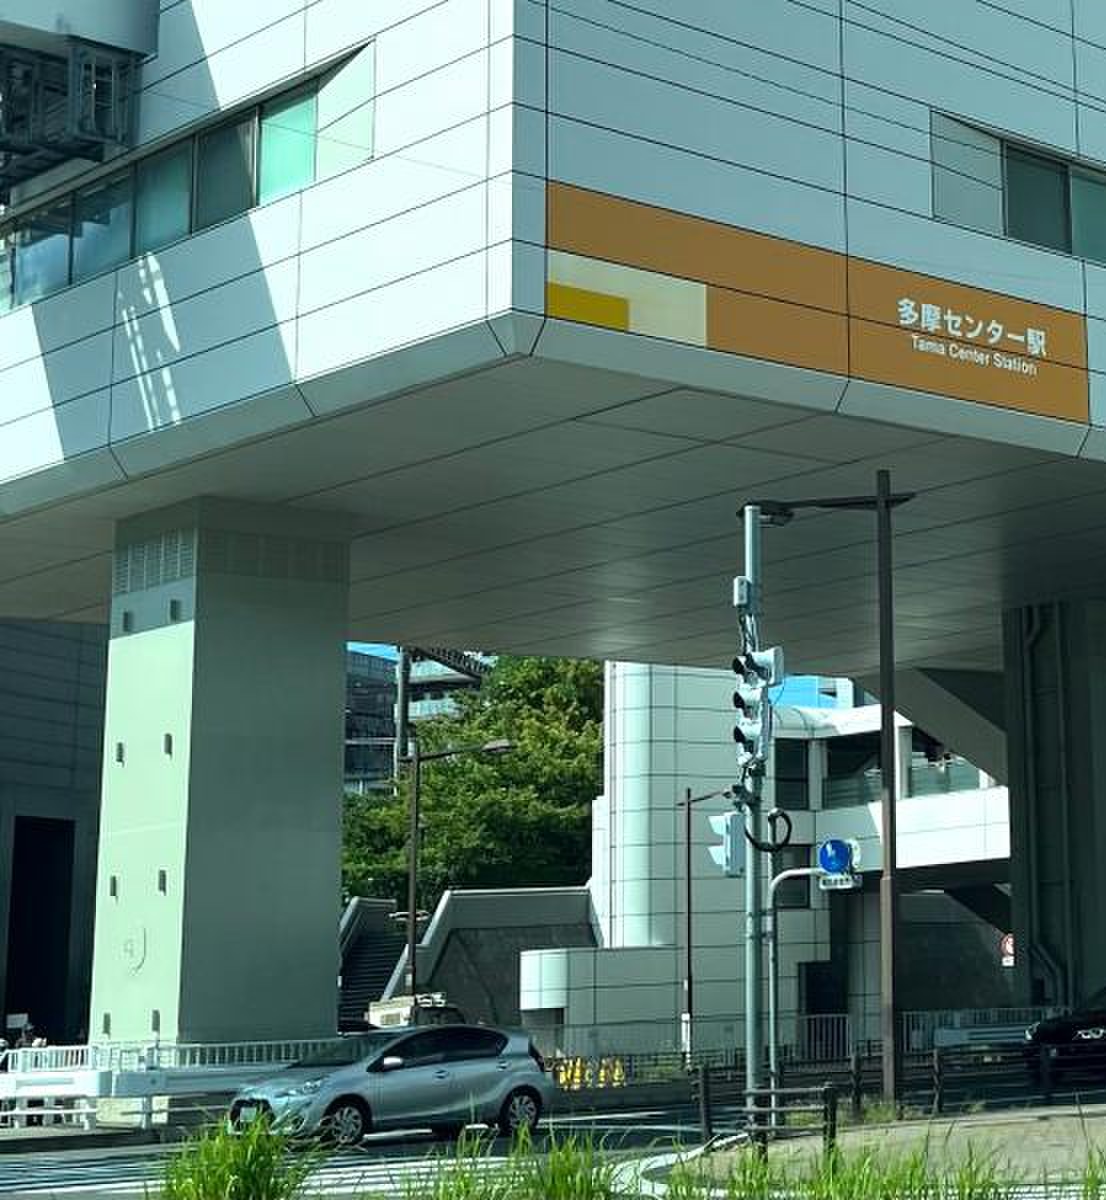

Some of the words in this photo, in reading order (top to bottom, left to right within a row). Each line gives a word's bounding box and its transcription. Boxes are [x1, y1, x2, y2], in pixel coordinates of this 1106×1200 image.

[897, 298, 1047, 356] 多摩センター駅
[912, 333, 945, 355] Tama
[949, 343, 990, 366] Center
[993, 352, 1038, 376] Station
